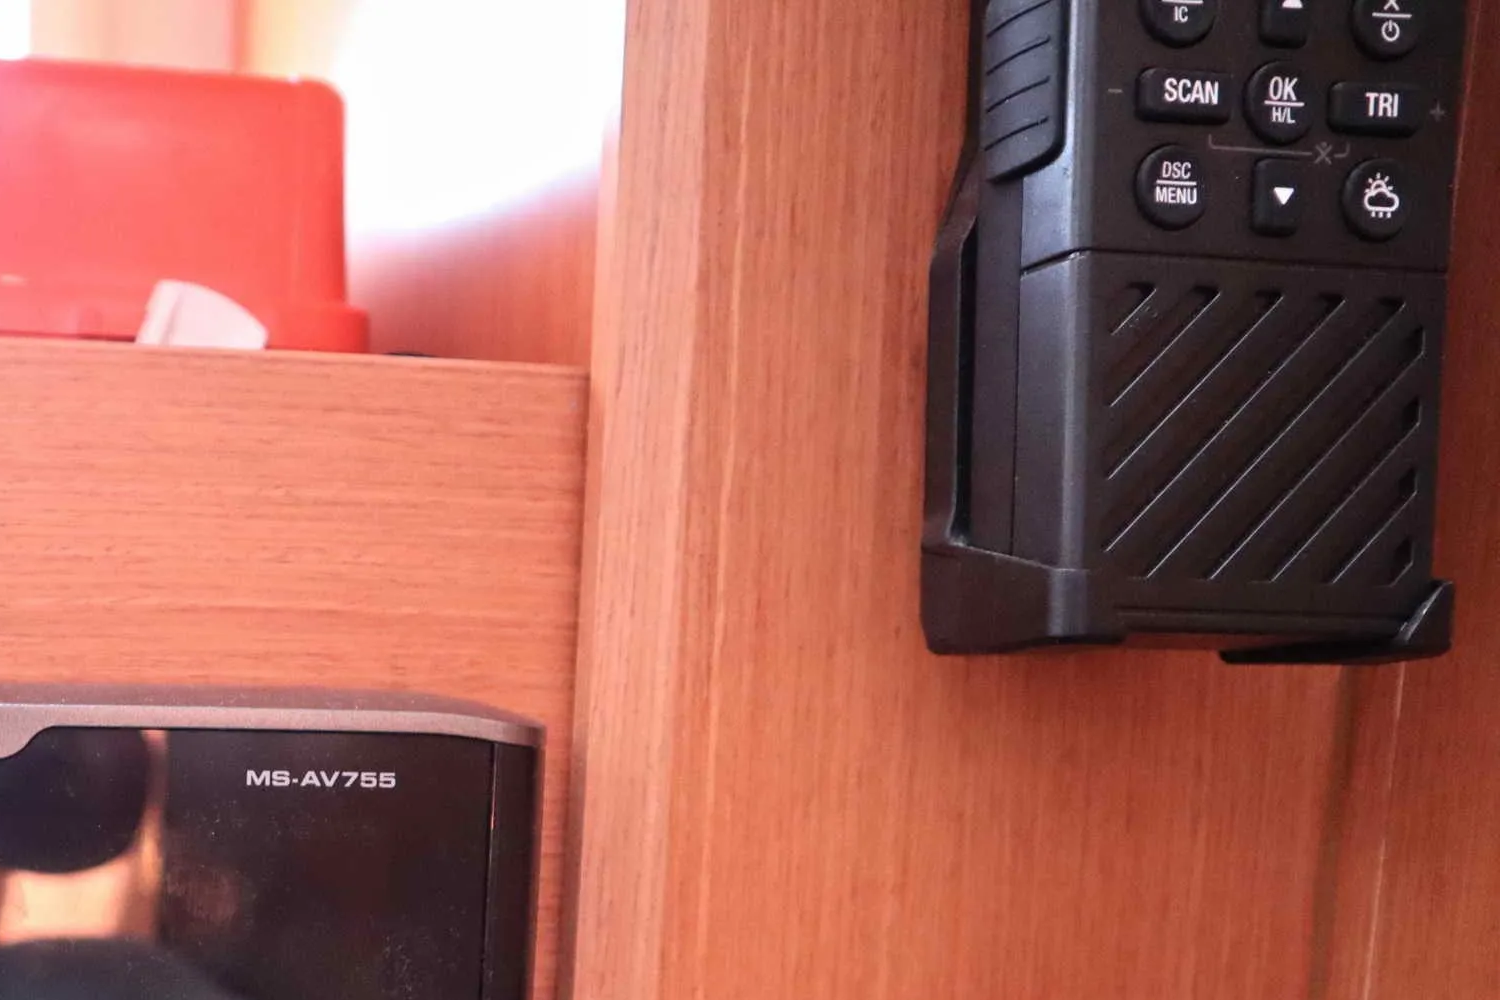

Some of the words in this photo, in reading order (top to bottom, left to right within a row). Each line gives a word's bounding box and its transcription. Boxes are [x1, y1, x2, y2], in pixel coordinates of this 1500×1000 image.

[1174, 6, 1189, 23] IC
[1164, 77, 1219, 106] SCAN
[1269, 76, 1299, 101] OK
[1271, 107, 1296, 124] H/L
[1365, 92, 1399, 118] TRI
[1161, 161, 1192, 179] DSC
[1155, 185, 1198, 205] MENU
[245, 768, 397, 790] MS-AV755
